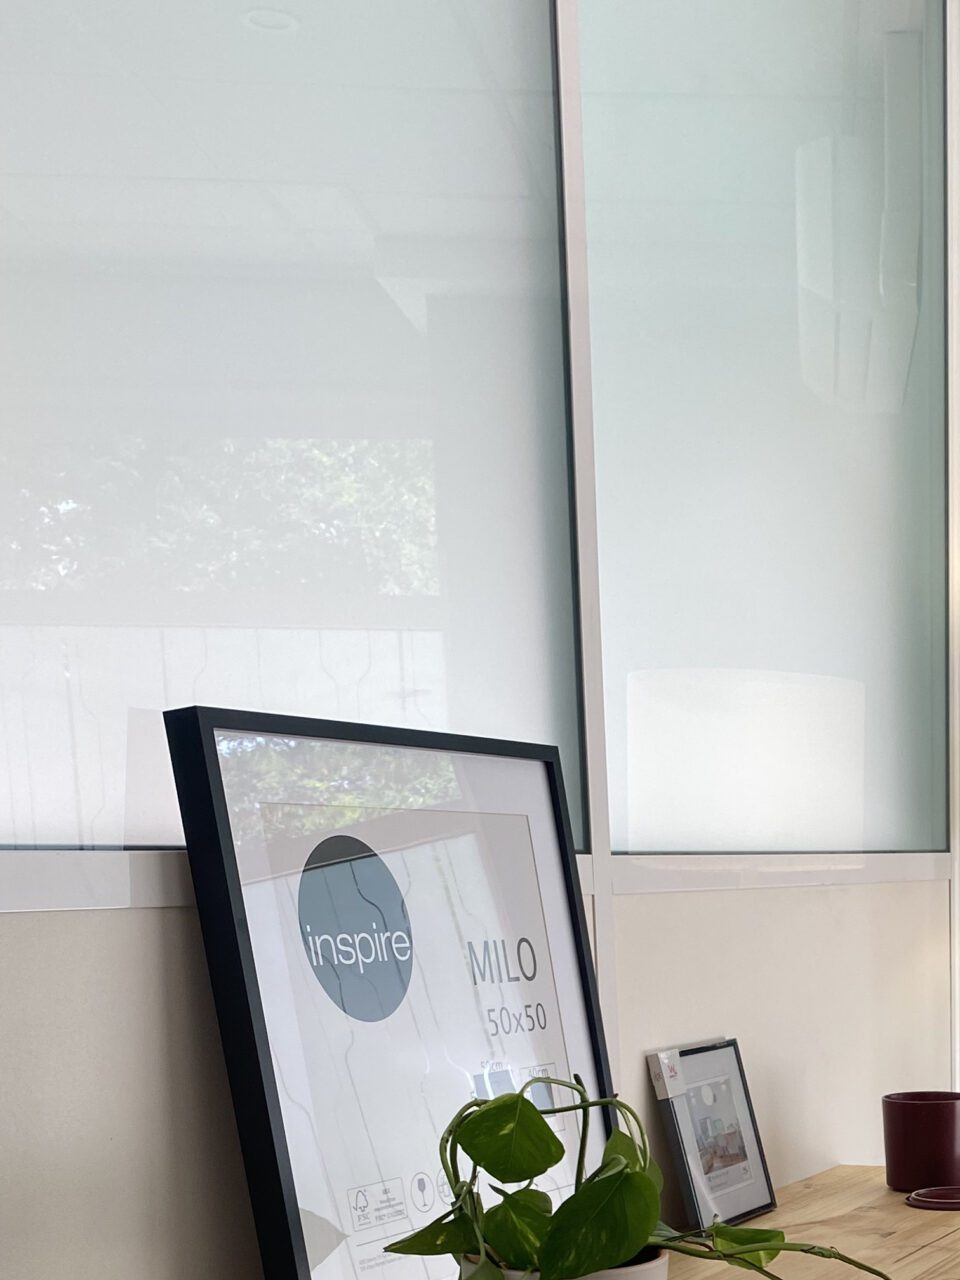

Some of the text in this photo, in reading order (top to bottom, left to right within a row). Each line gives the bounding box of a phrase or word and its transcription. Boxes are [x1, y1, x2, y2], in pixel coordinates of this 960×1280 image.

[306, 922, 412, 974] inspire
[466, 937, 537, 986] MILO
[487, 1002, 547, 1037] 50x50
